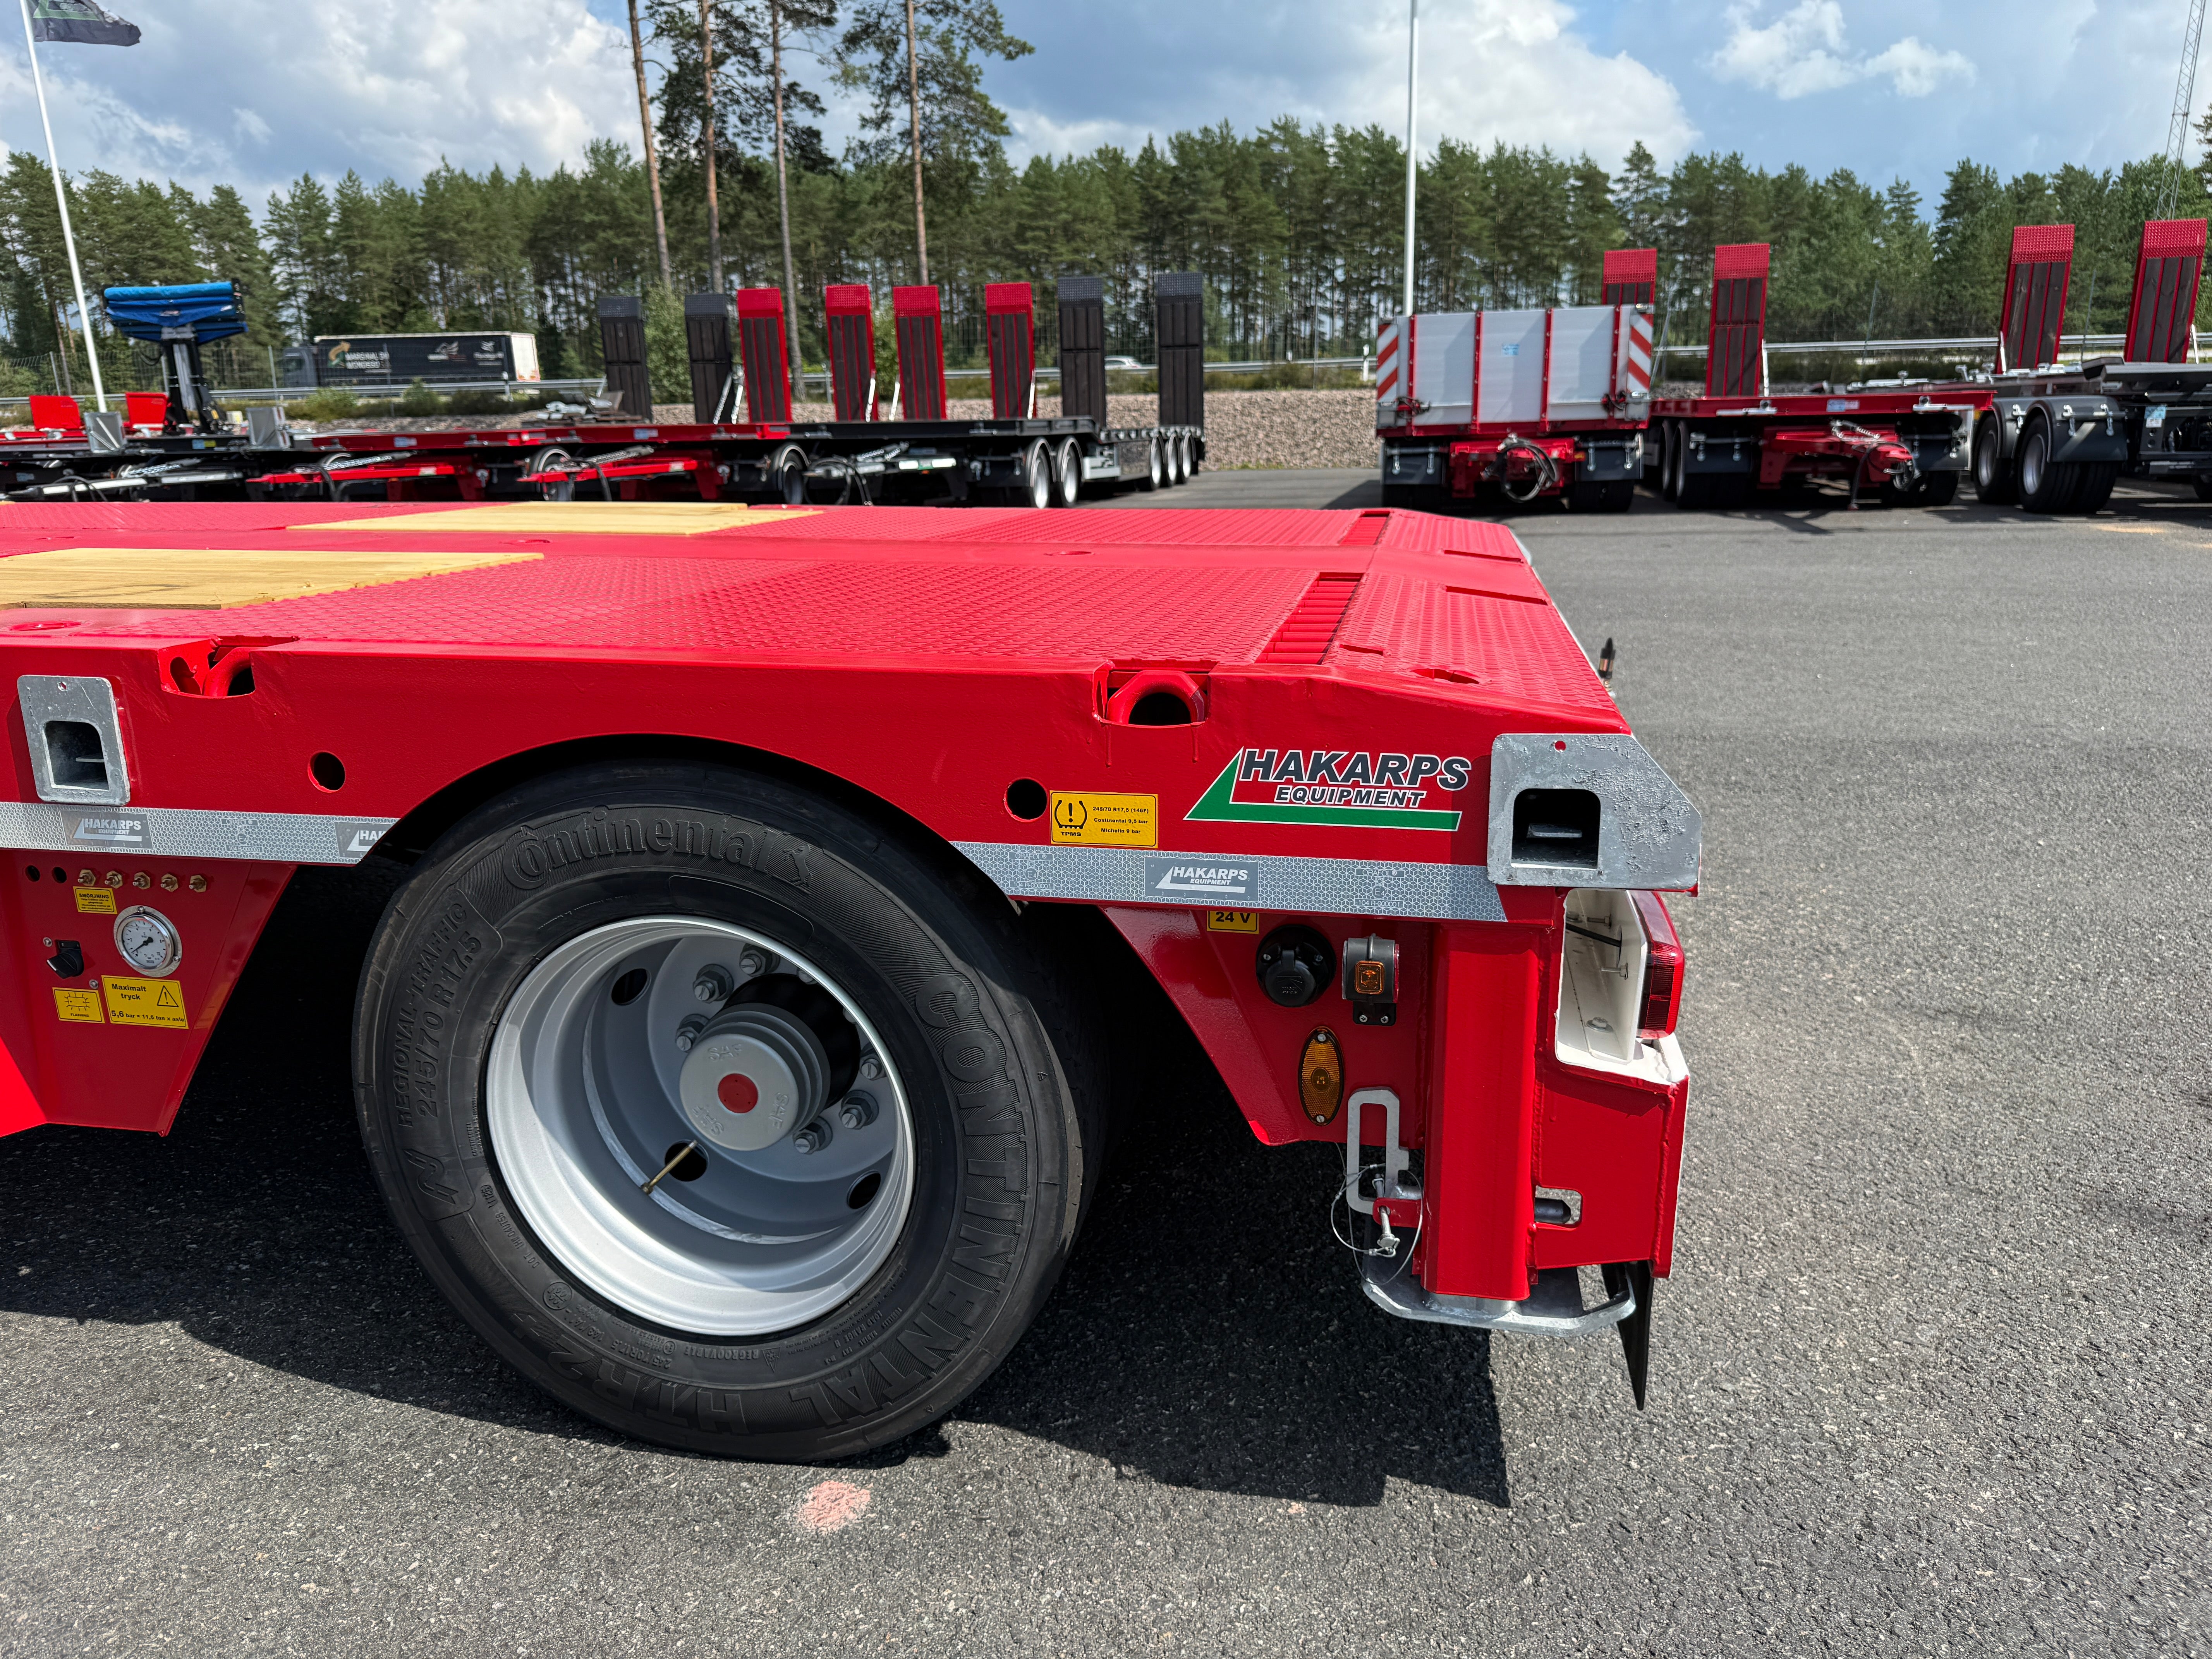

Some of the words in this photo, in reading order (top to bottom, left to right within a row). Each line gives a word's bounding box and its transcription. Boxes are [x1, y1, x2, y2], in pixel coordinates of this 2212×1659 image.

[1239, 749, 1472, 791] HAKARPS
[1274, 785, 1427, 808] EQUIPMENT
[84, 818, 141, 830] HAKARPS
[501, 809, 773, 890] Continental
[1173, 866, 1249, 880] HAKARPS
[1215, 911, 1235, 922] 24
[1239, 912, 1251, 923] V
[112, 984, 147, 992] Maximalt
[111, 1010, 124, 1018] 5,6
[415, 1010, 444, 1118] 245/70
[789, 975, 1022, 1424] CONTINENTAL
[684, 1345, 760, 1360] REGROOVABLE
